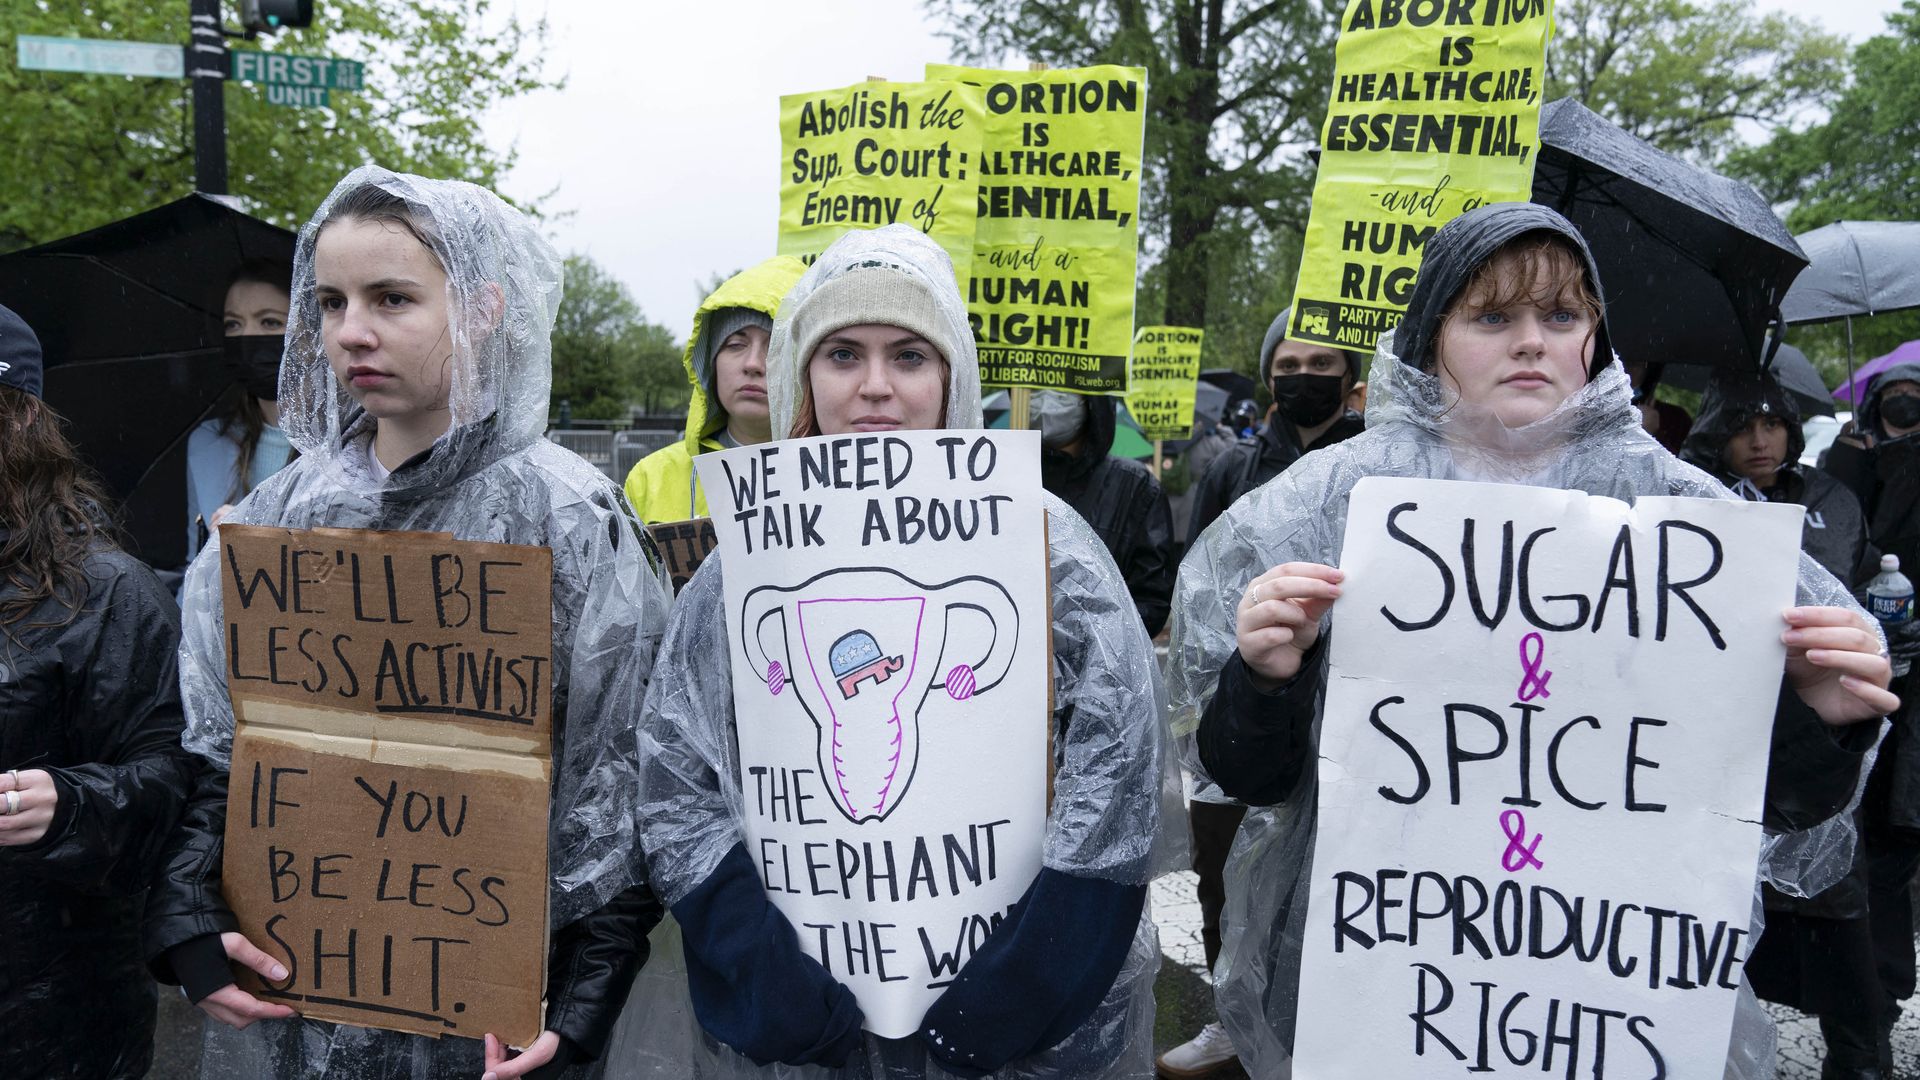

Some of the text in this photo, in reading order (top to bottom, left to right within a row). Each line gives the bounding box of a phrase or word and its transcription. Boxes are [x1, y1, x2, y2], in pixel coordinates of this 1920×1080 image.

[237, 53, 332, 85] FIRST
[1439, 37, 1474, 66] IS
[268, 85, 325, 105] UNIT
[987, 80, 1137, 115] ORTION
[1337, 67, 1537, 105] HEALTHCARE,
[799, 90, 964, 138] Abolish the
[1023, 123, 1049, 147] IS
[1327, 114, 1530, 165] ESSENTIAL,
[980, 151, 1132, 181] ALTHCARE,
[802, 185, 943, 233] Enemy of
[977, 185, 1132, 227] SENTIAL,
[1342, 221, 1437, 257] HUM
[1340, 263, 1417, 305] RIG
[968, 312, 1090, 349] RIGHT!
[1300, 314, 1330, 336] PSL
[1335, 326, 1361, 344] AND
[1339, 306, 1403, 328] PARTY FO
[977, 350, 1100, 371] RTY FOR SOCIALISM
[992, 368, 1066, 385] LIBERATION
[1133, 369, 1194, 381] SSENTIAL,
[721, 435, 997, 512] WE NEED TO
[861, 494, 1013, 547] ABOUT
[227, 543, 523, 635] WE'LL BE
[1380, 501, 1727, 650] SUGAR
[230, 623, 548, 718] LESS ACTIVIST
[1517, 631, 1552, 702] &
[1369, 695, 1668, 812] SPICE
[251, 761, 468, 838] IF YOU
[748, 766, 827, 825] THE
[760, 819, 1011, 902] ELEPHANT
[1498, 809, 1545, 873] &
[269, 845, 509, 927] BE LESS
[803, 903, 1017, 982] THE WO
[1332, 868, 1750, 991] REPRODUCTIVE
[258, 914, 470, 1013] SHIT.
[1408, 962, 1666, 1080] RIGHTS
